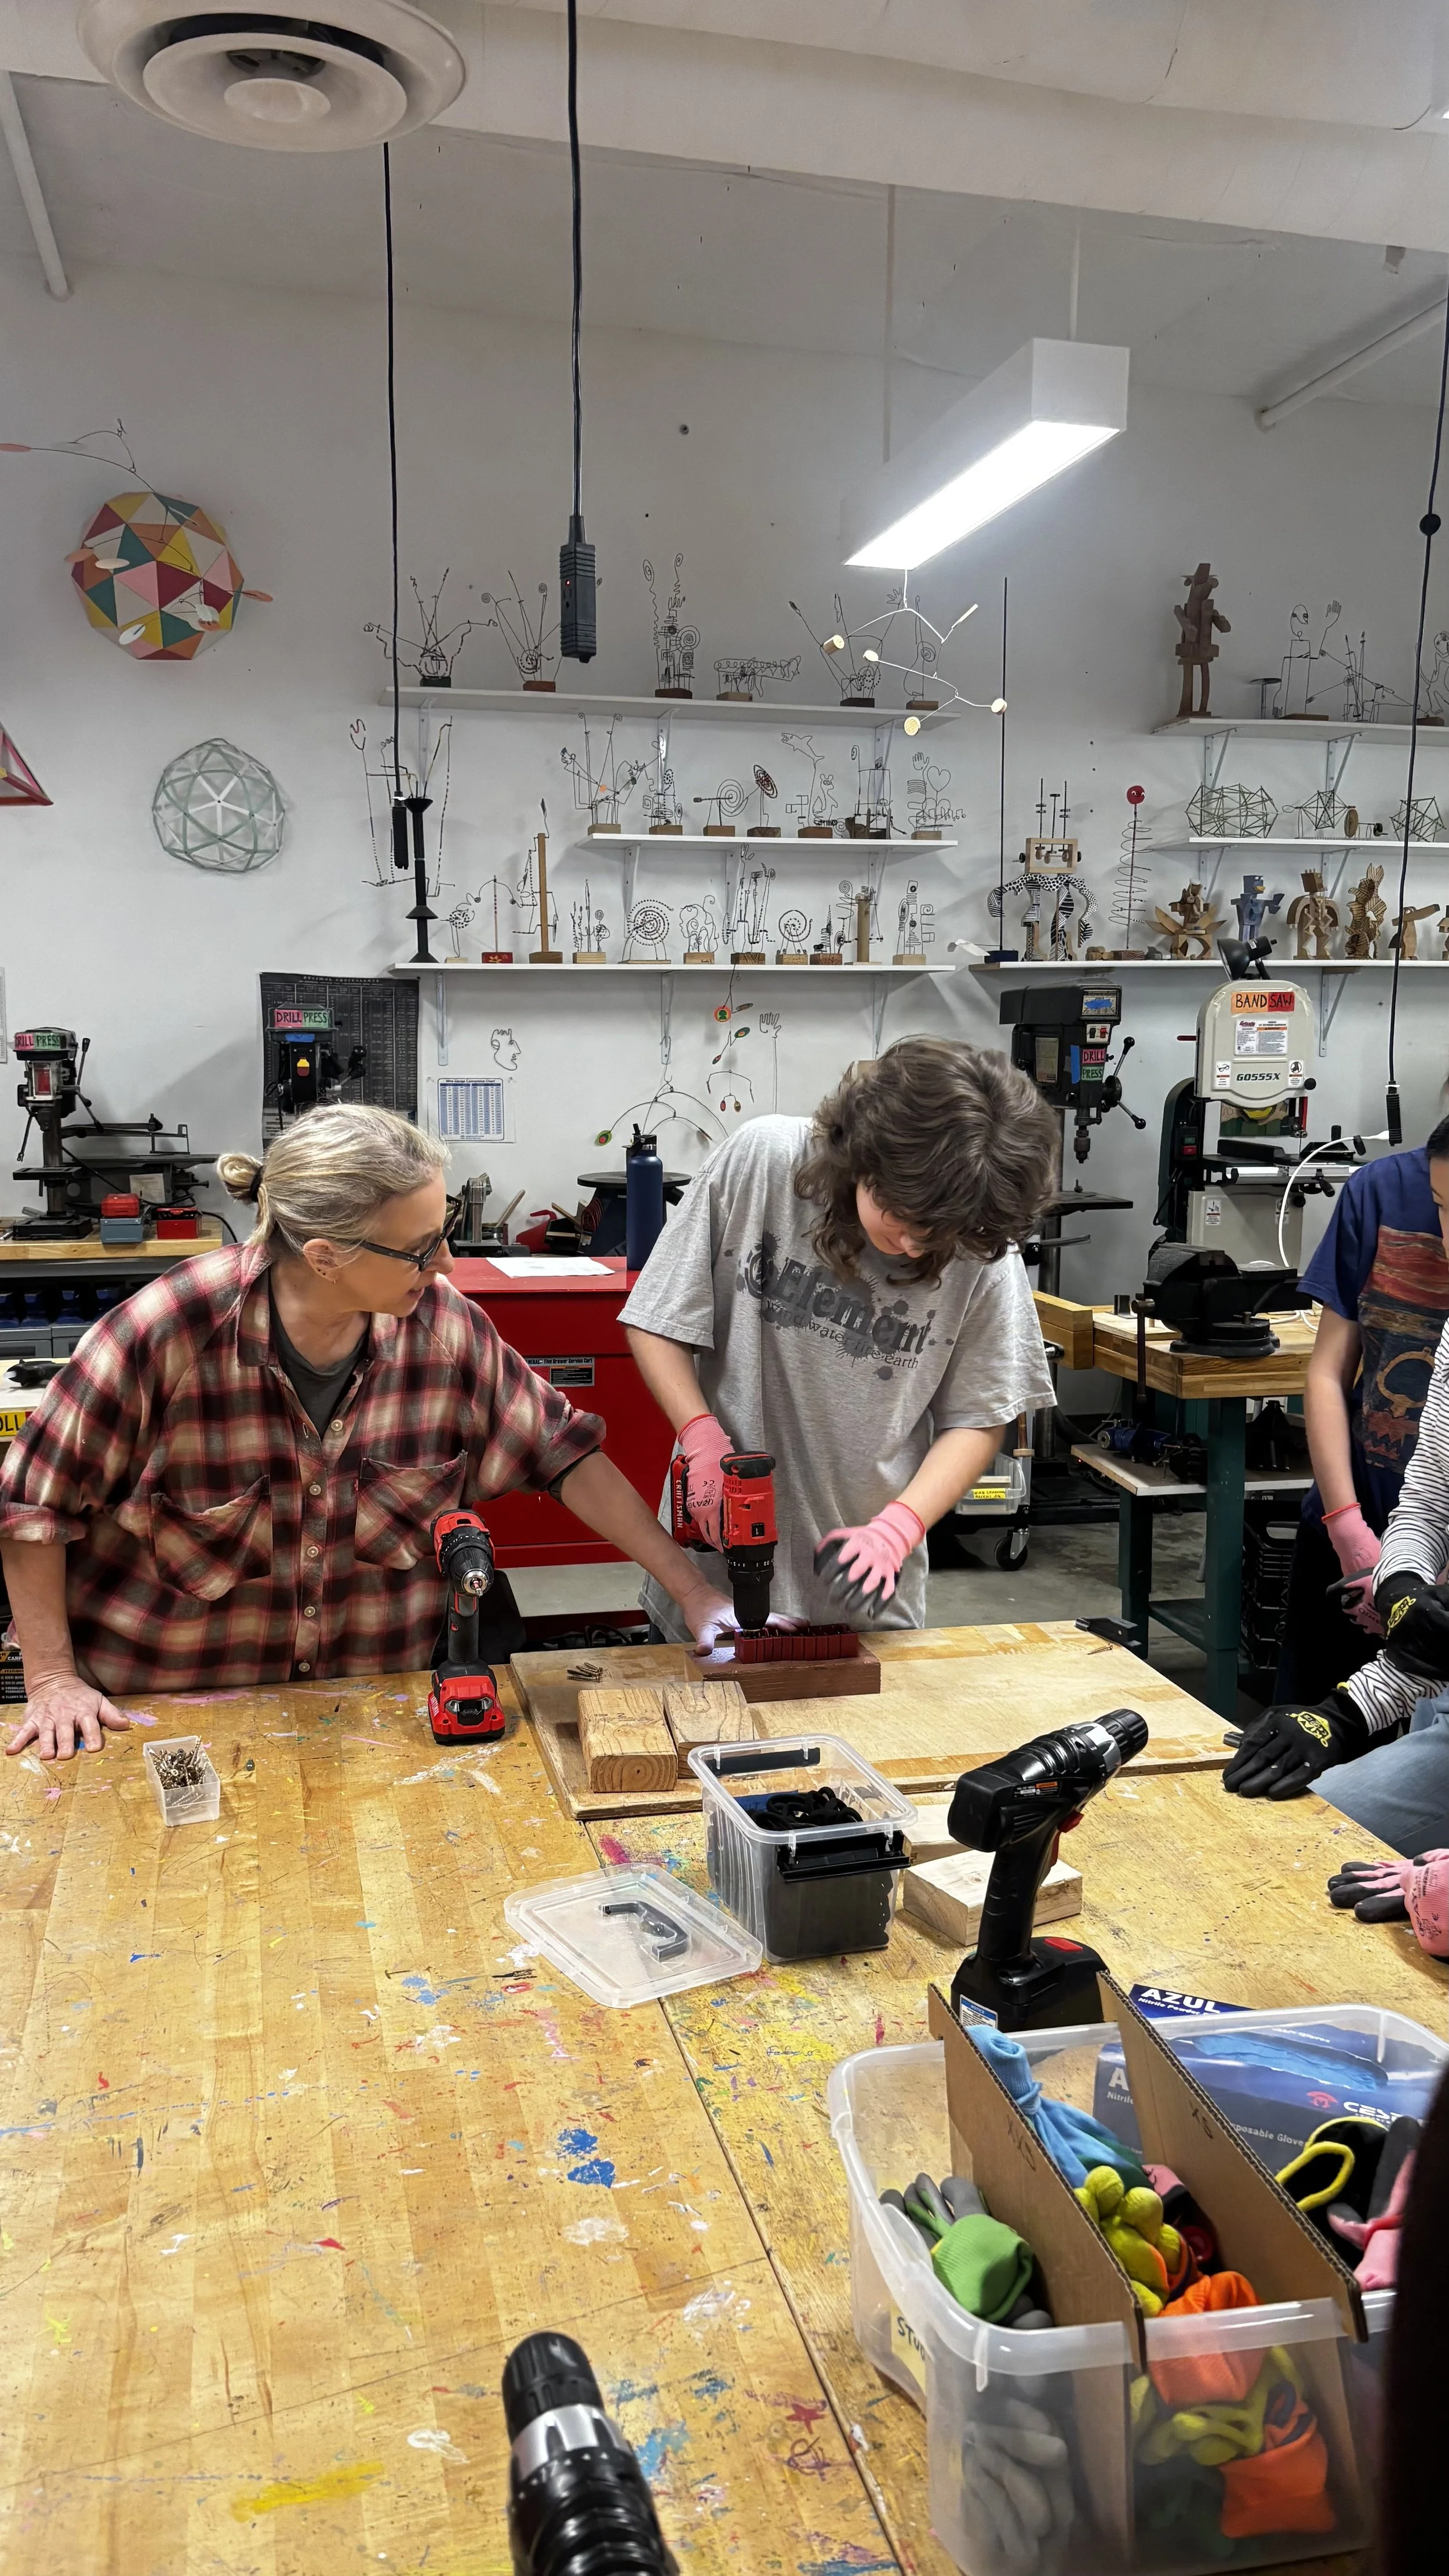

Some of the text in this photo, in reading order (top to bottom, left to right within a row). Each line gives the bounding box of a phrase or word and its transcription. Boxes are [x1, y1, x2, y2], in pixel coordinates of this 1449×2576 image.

[1236, 994, 1293, 1008] BAND SAW
[276, 1012, 327, 1024] DRILL PRESS
[1083, 1049, 1105, 1062] DRILL
[1082, 1069, 1102, 1079] PRESS
[776, 1256, 932, 1355] Element
[676, 1479, 684, 1529] CRAFTSMAN
[1137, 1998, 1200, 2015] Nitrile Powder
[1140, 1988, 1221, 2014] AZUL
[1277, 2133, 1304, 2147] Glove
